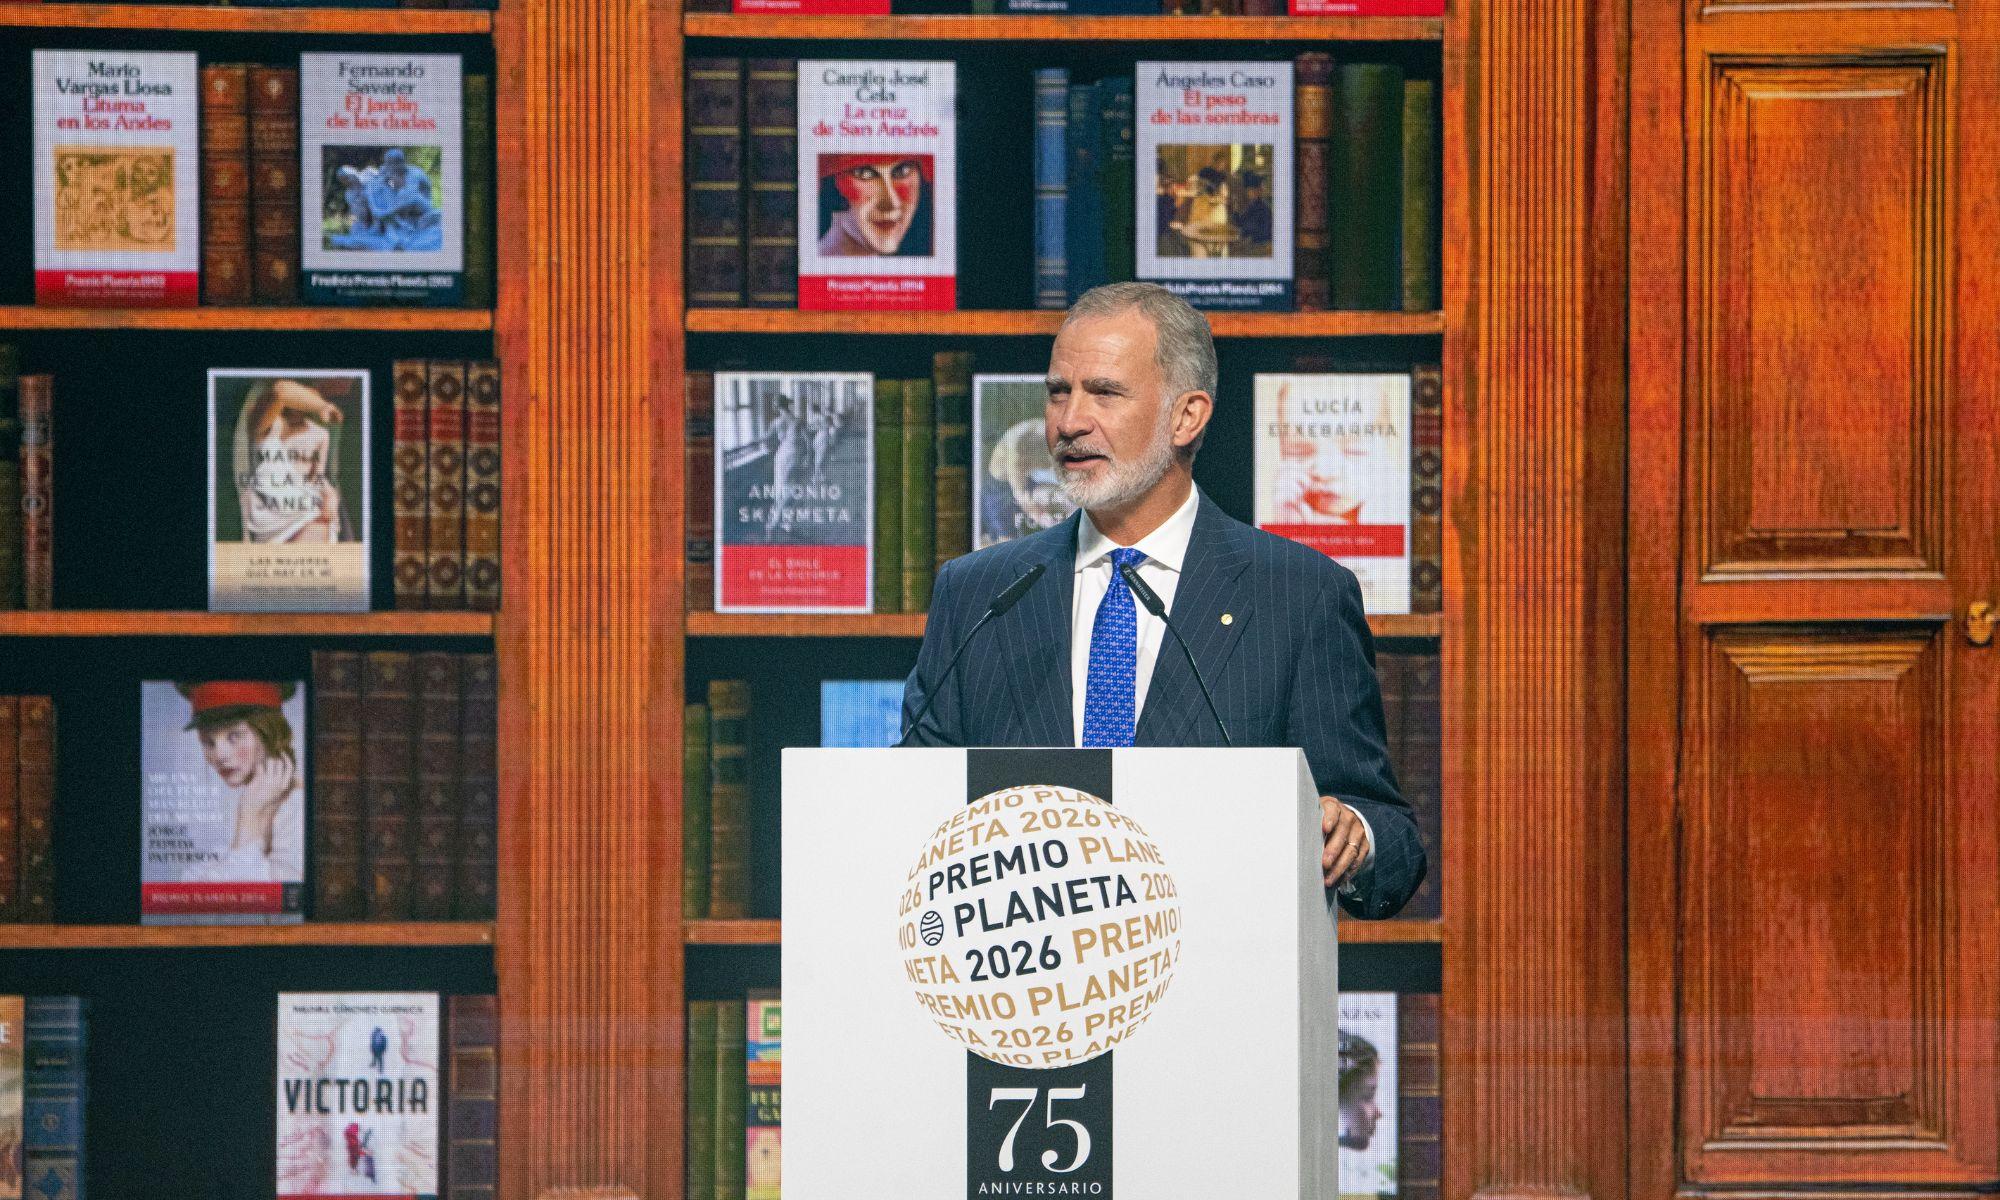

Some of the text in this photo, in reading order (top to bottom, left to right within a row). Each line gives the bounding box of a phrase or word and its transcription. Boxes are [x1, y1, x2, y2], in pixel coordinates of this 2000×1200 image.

[88, 61, 140, 78] Mario
[337, 61, 425, 78] Fernando
[822, 69, 928, 86] Camilo José
[1156, 67, 1275, 90] Ángeles Caso
[56, 78, 172, 97] Vargas Llosa
[347, 79, 415, 95] Savater
[856, 85, 896, 103] Cela
[83, 97, 145, 113] Lituma
[345, 94, 362, 112] El
[1184, 90, 1247, 109] El peso
[845, 103, 907, 120] La cruz
[1150, 108, 1280, 126] de las sombras
[56, 114, 172, 131] en los Andes
[326, 112, 436, 130] de las dudas
[813, 121, 938, 137] de San Andrés
[1303, 396, 1363, 414] LUCÍA
[1268, 423, 1398, 437] ETXEBARRIA
[748, 484, 841, 501] ANTONIO
[930, 794, 1024, 841] REMIO
[1020, 807, 1101, 833] 2026
[929, 839, 1069, 901] PREMIO
[1078, 836, 1165, 866] PLANE
[953, 874, 1137, 938] PLANETA
[1140, 872, 1177, 901] 202
[905, 954, 961, 984] NETA
[965, 935, 1062, 982] 2026
[1072, 908, 1177, 964] PREMIO
[915, 991, 1016, 1021] PREMIO
[1027, 947, 1171, 1016] PLANETA
[933, 1019, 988, 1047] ETA
[990, 1021, 1074, 1048] 2026
[284, 1078, 427, 1114] VICTORIA
[989, 1083, 1091, 1173] 75
[978, 1182, 1102, 1195] ANIVERSARIO
